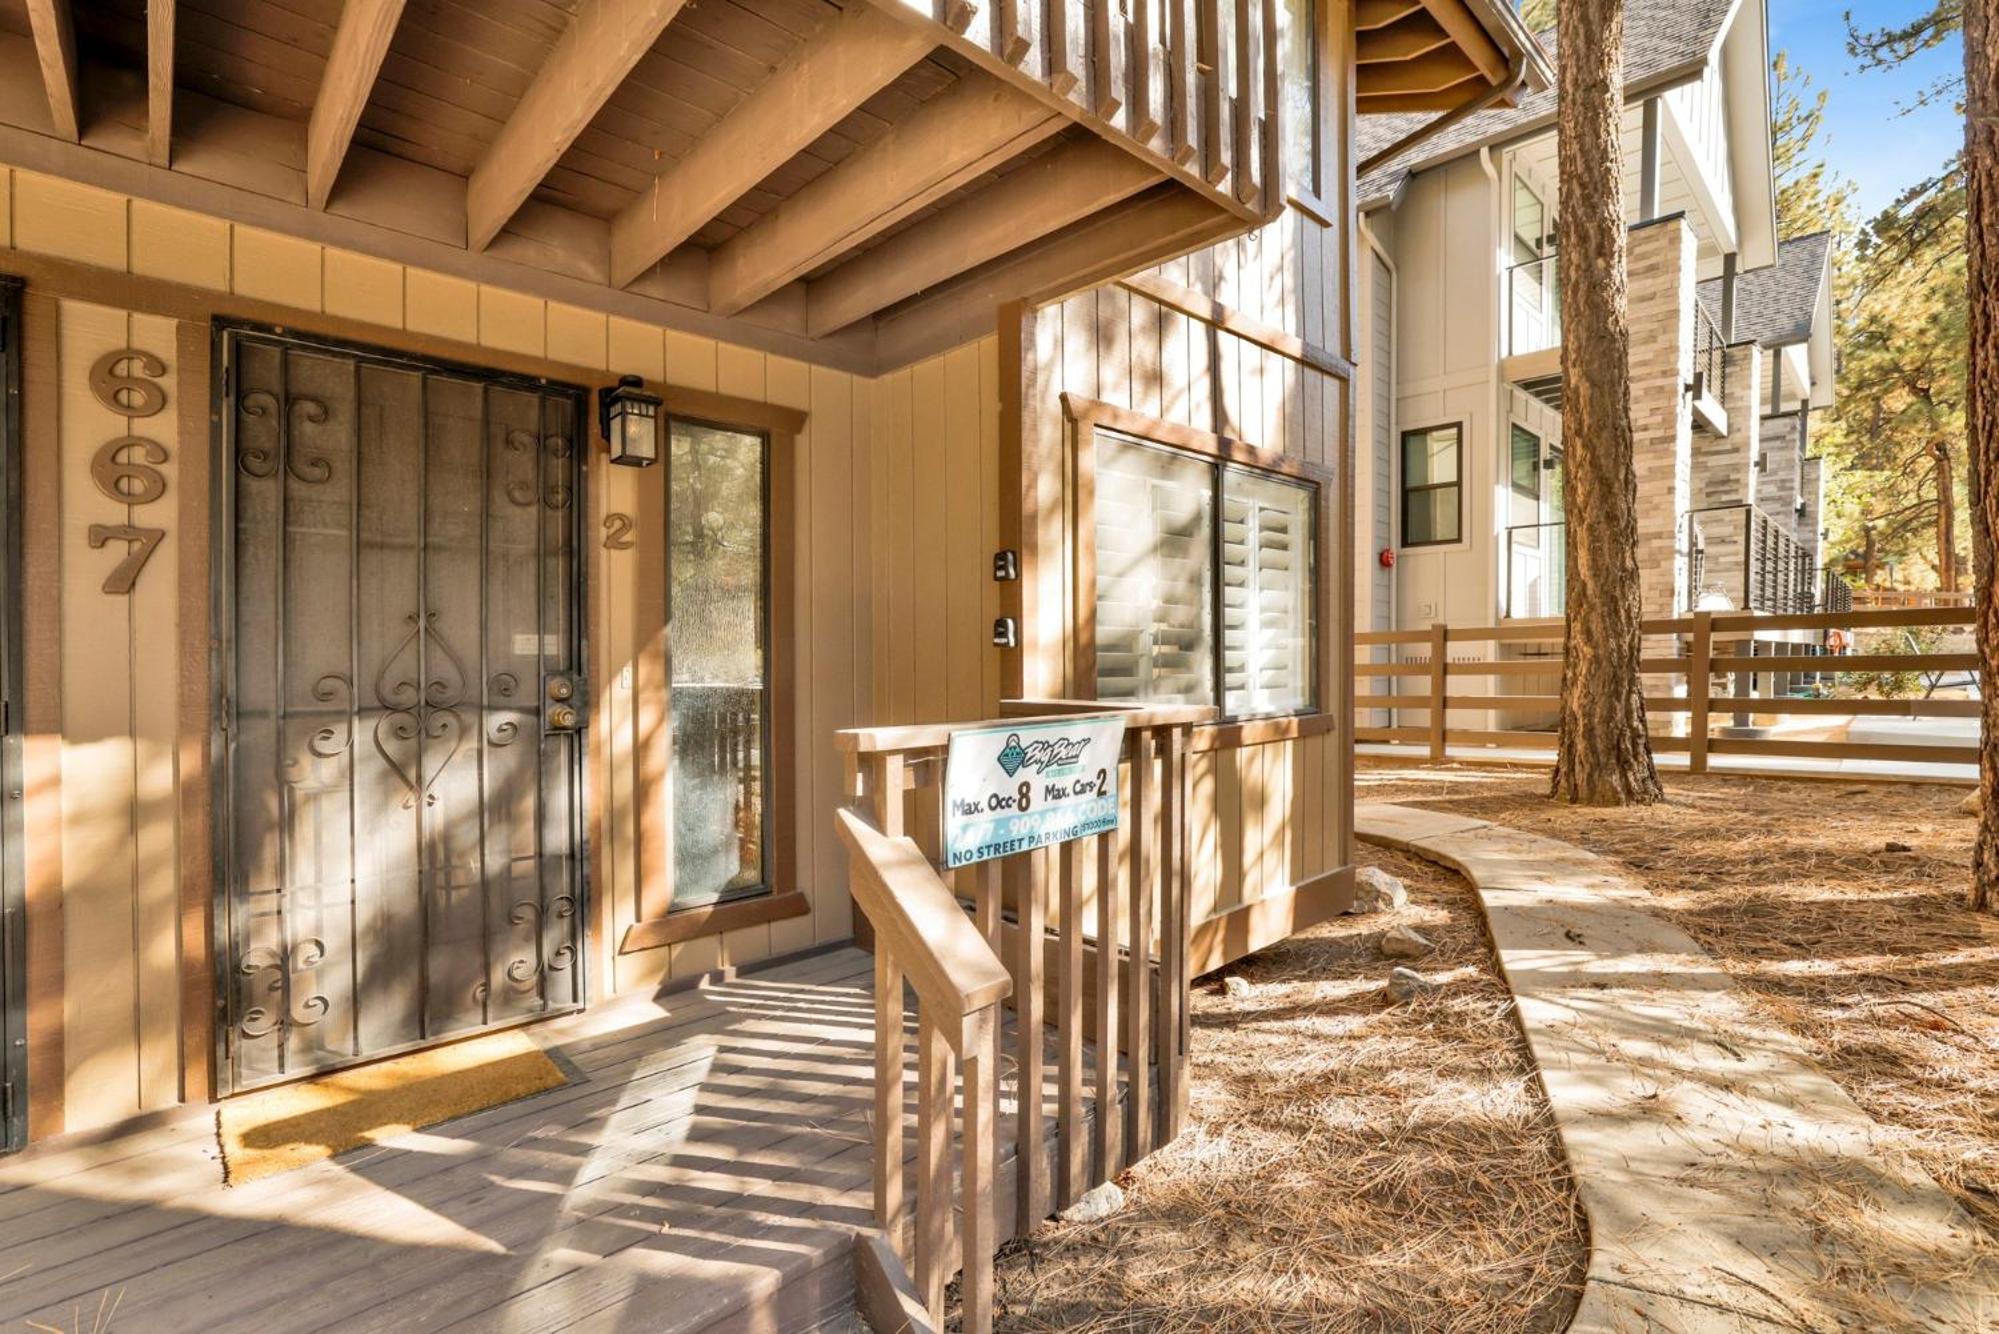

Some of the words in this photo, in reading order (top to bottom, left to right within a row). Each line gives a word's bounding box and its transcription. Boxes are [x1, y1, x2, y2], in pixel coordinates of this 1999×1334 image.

[89, 348, 168, 595] 667
[603, 512, 635, 551] 2
[952, 797, 985, 818] Max.
[1044, 784, 1070, 802] Max.
[953, 849, 974, 865] NO
[977, 838, 1025, 860] STREET
[1028, 824, 1079, 848] PARKING
